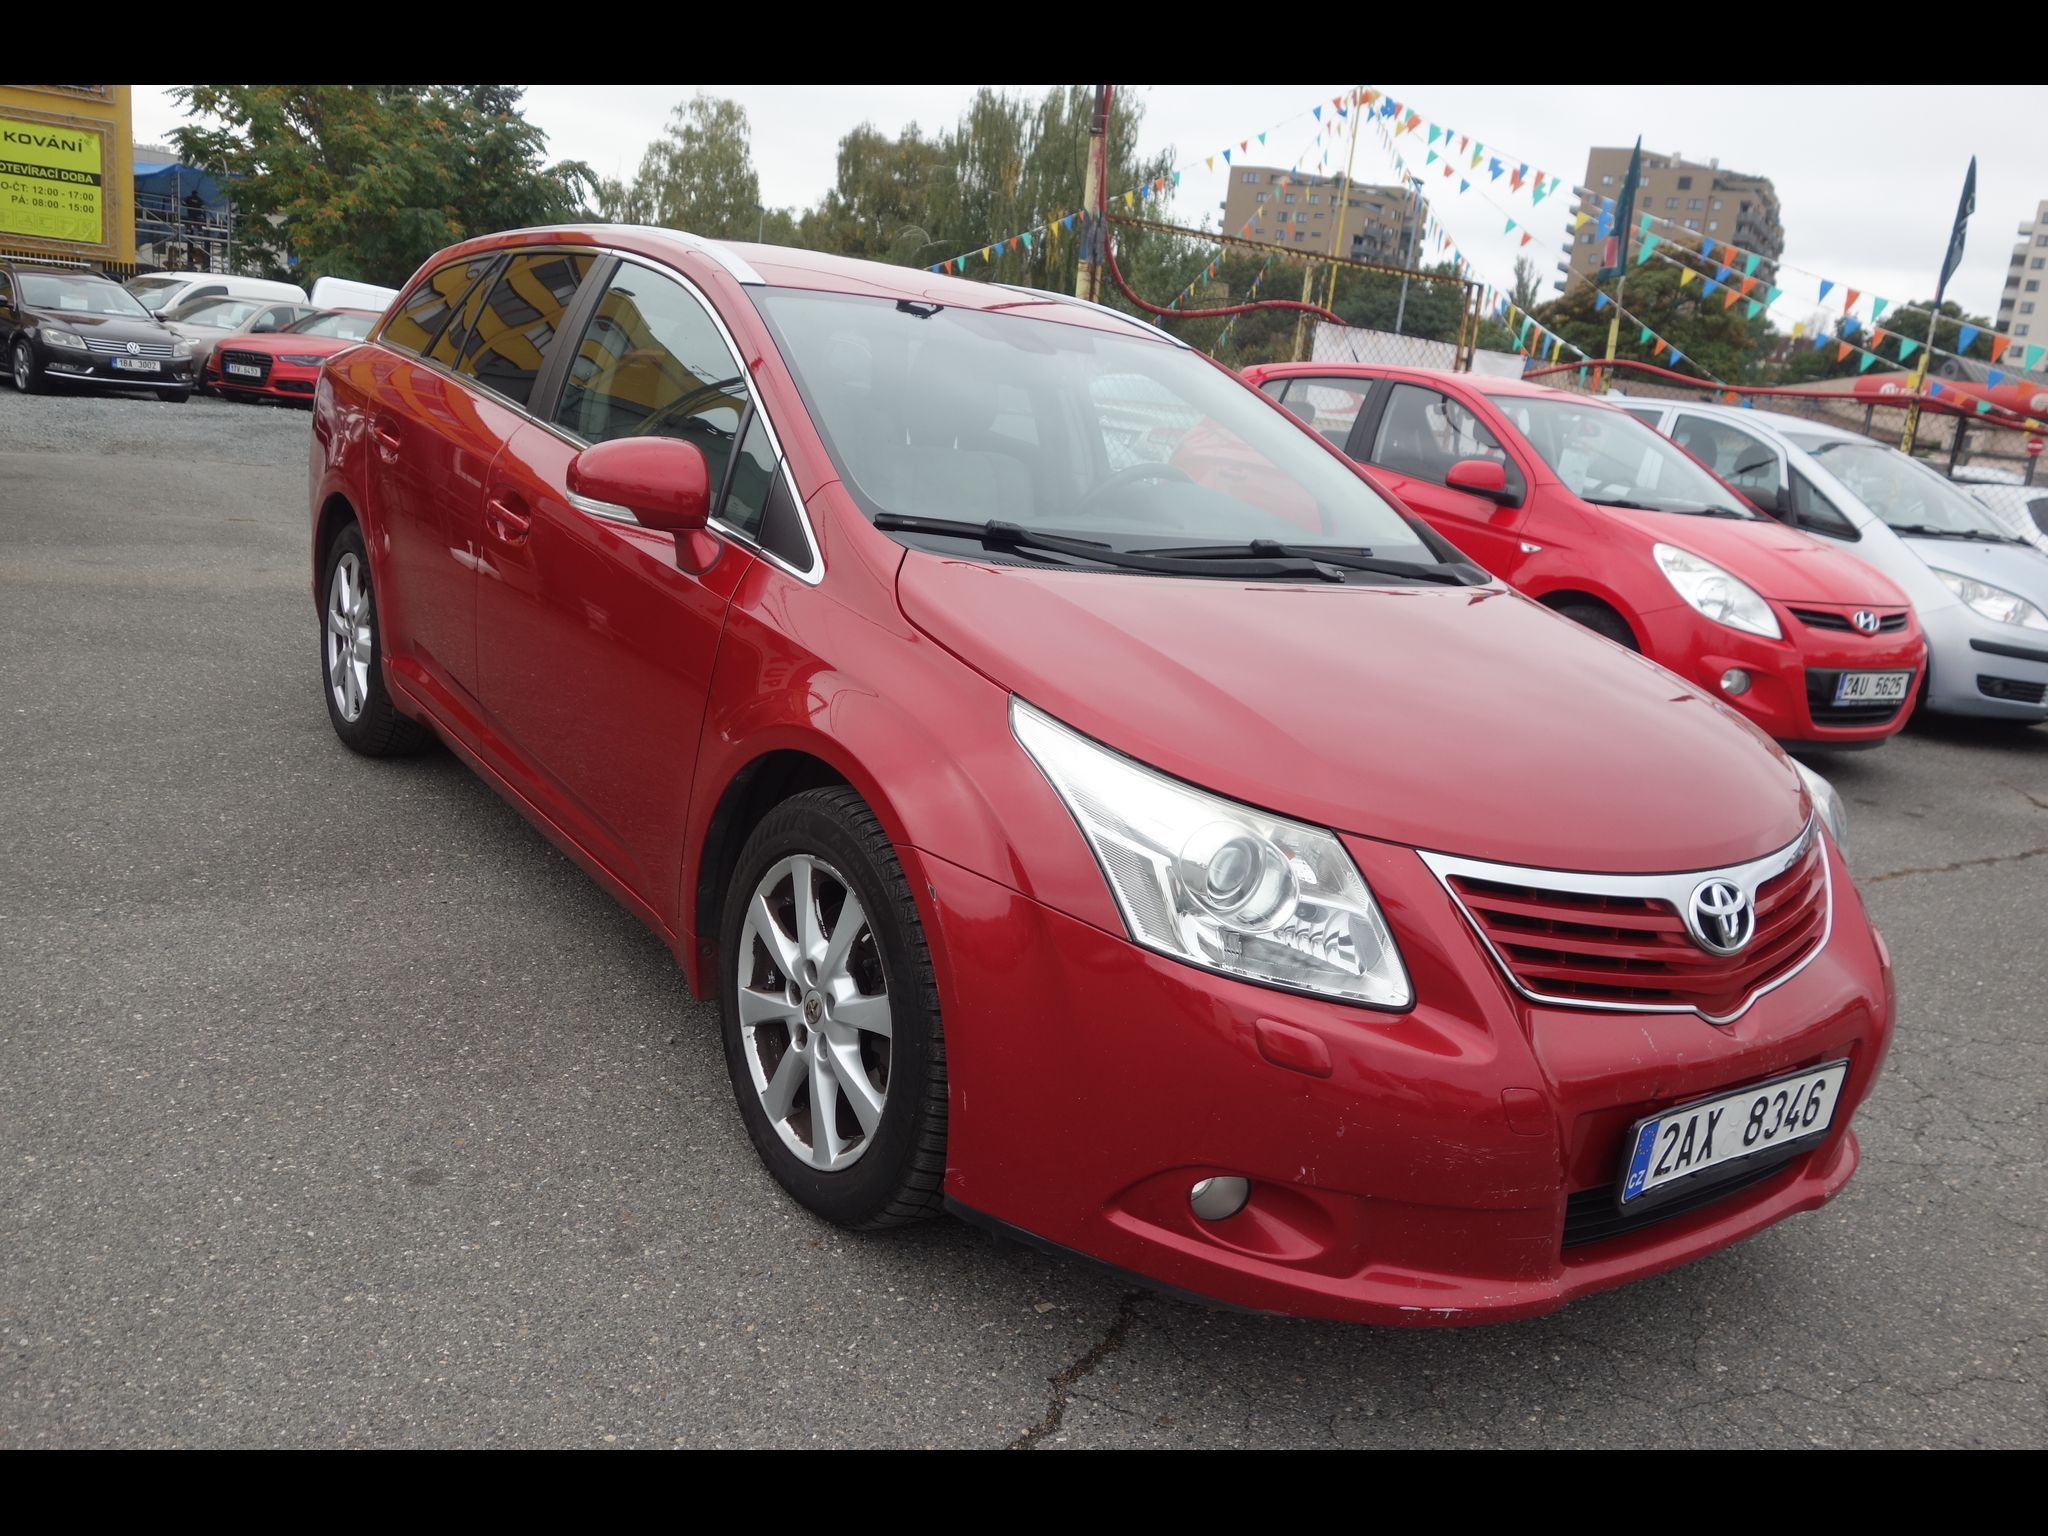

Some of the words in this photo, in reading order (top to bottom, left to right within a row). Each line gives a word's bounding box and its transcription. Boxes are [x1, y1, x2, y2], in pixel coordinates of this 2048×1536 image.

[4, 131, 82, 152] KOVÁNÍ
[0, 162, 58, 179] OTEVÍRACÍ
[61, 171, 94, 184] DOBA
[33, 186, 59, 197] 12:00
[69, 191, 94, 202] 17:00
[11, 195, 29, 205] PÁ:
[32, 198, 59, 209] 08:00
[69, 203, 94, 214] 15:00
[1844, 676, 1870, 696] 2AU
[1875, 676, 1904, 696] 5625
[1653, 1107, 1725, 1178] 2AX
[1743, 1079, 1826, 1147] 8346
[1628, 1169, 1647, 1189] CZ
